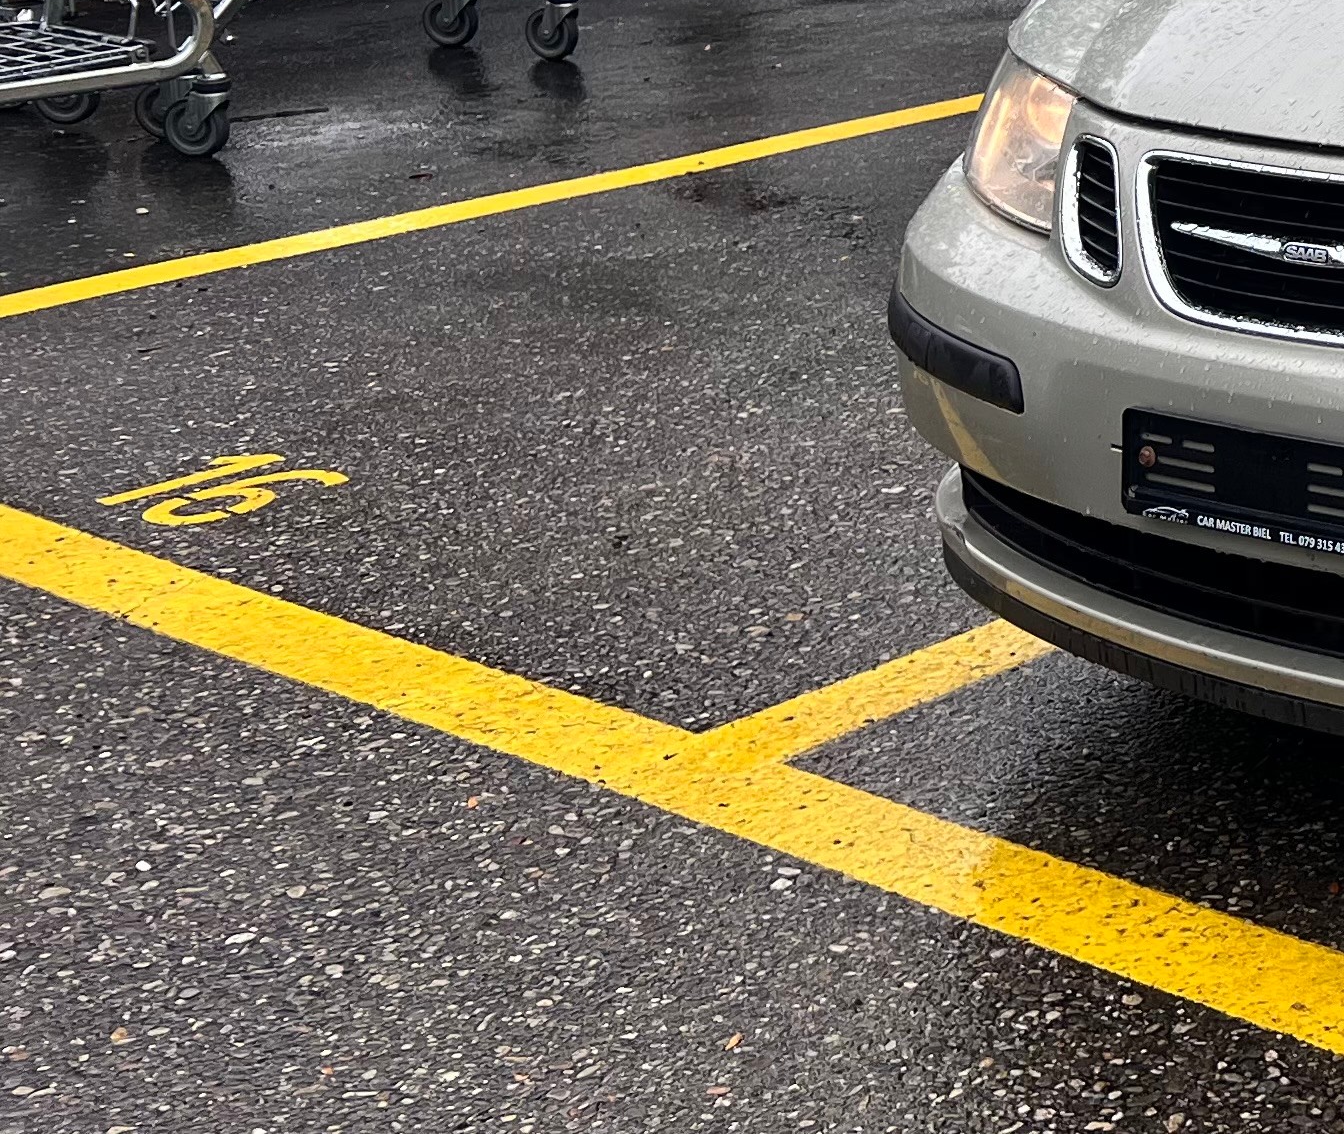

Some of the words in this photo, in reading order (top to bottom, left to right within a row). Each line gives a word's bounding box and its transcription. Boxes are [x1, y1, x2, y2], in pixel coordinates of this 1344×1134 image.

[1284, 245, 1327, 263] SAAB
[95, 453, 350, 527] 16
[1196, 514, 1215, 529] CAR
[1215, 517, 1252, 536] MASTER
[1252, 525, 1272, 540] BIEL
[1298, 535, 1316, 549] 079
[1316, 538, 1334, 552] 315
